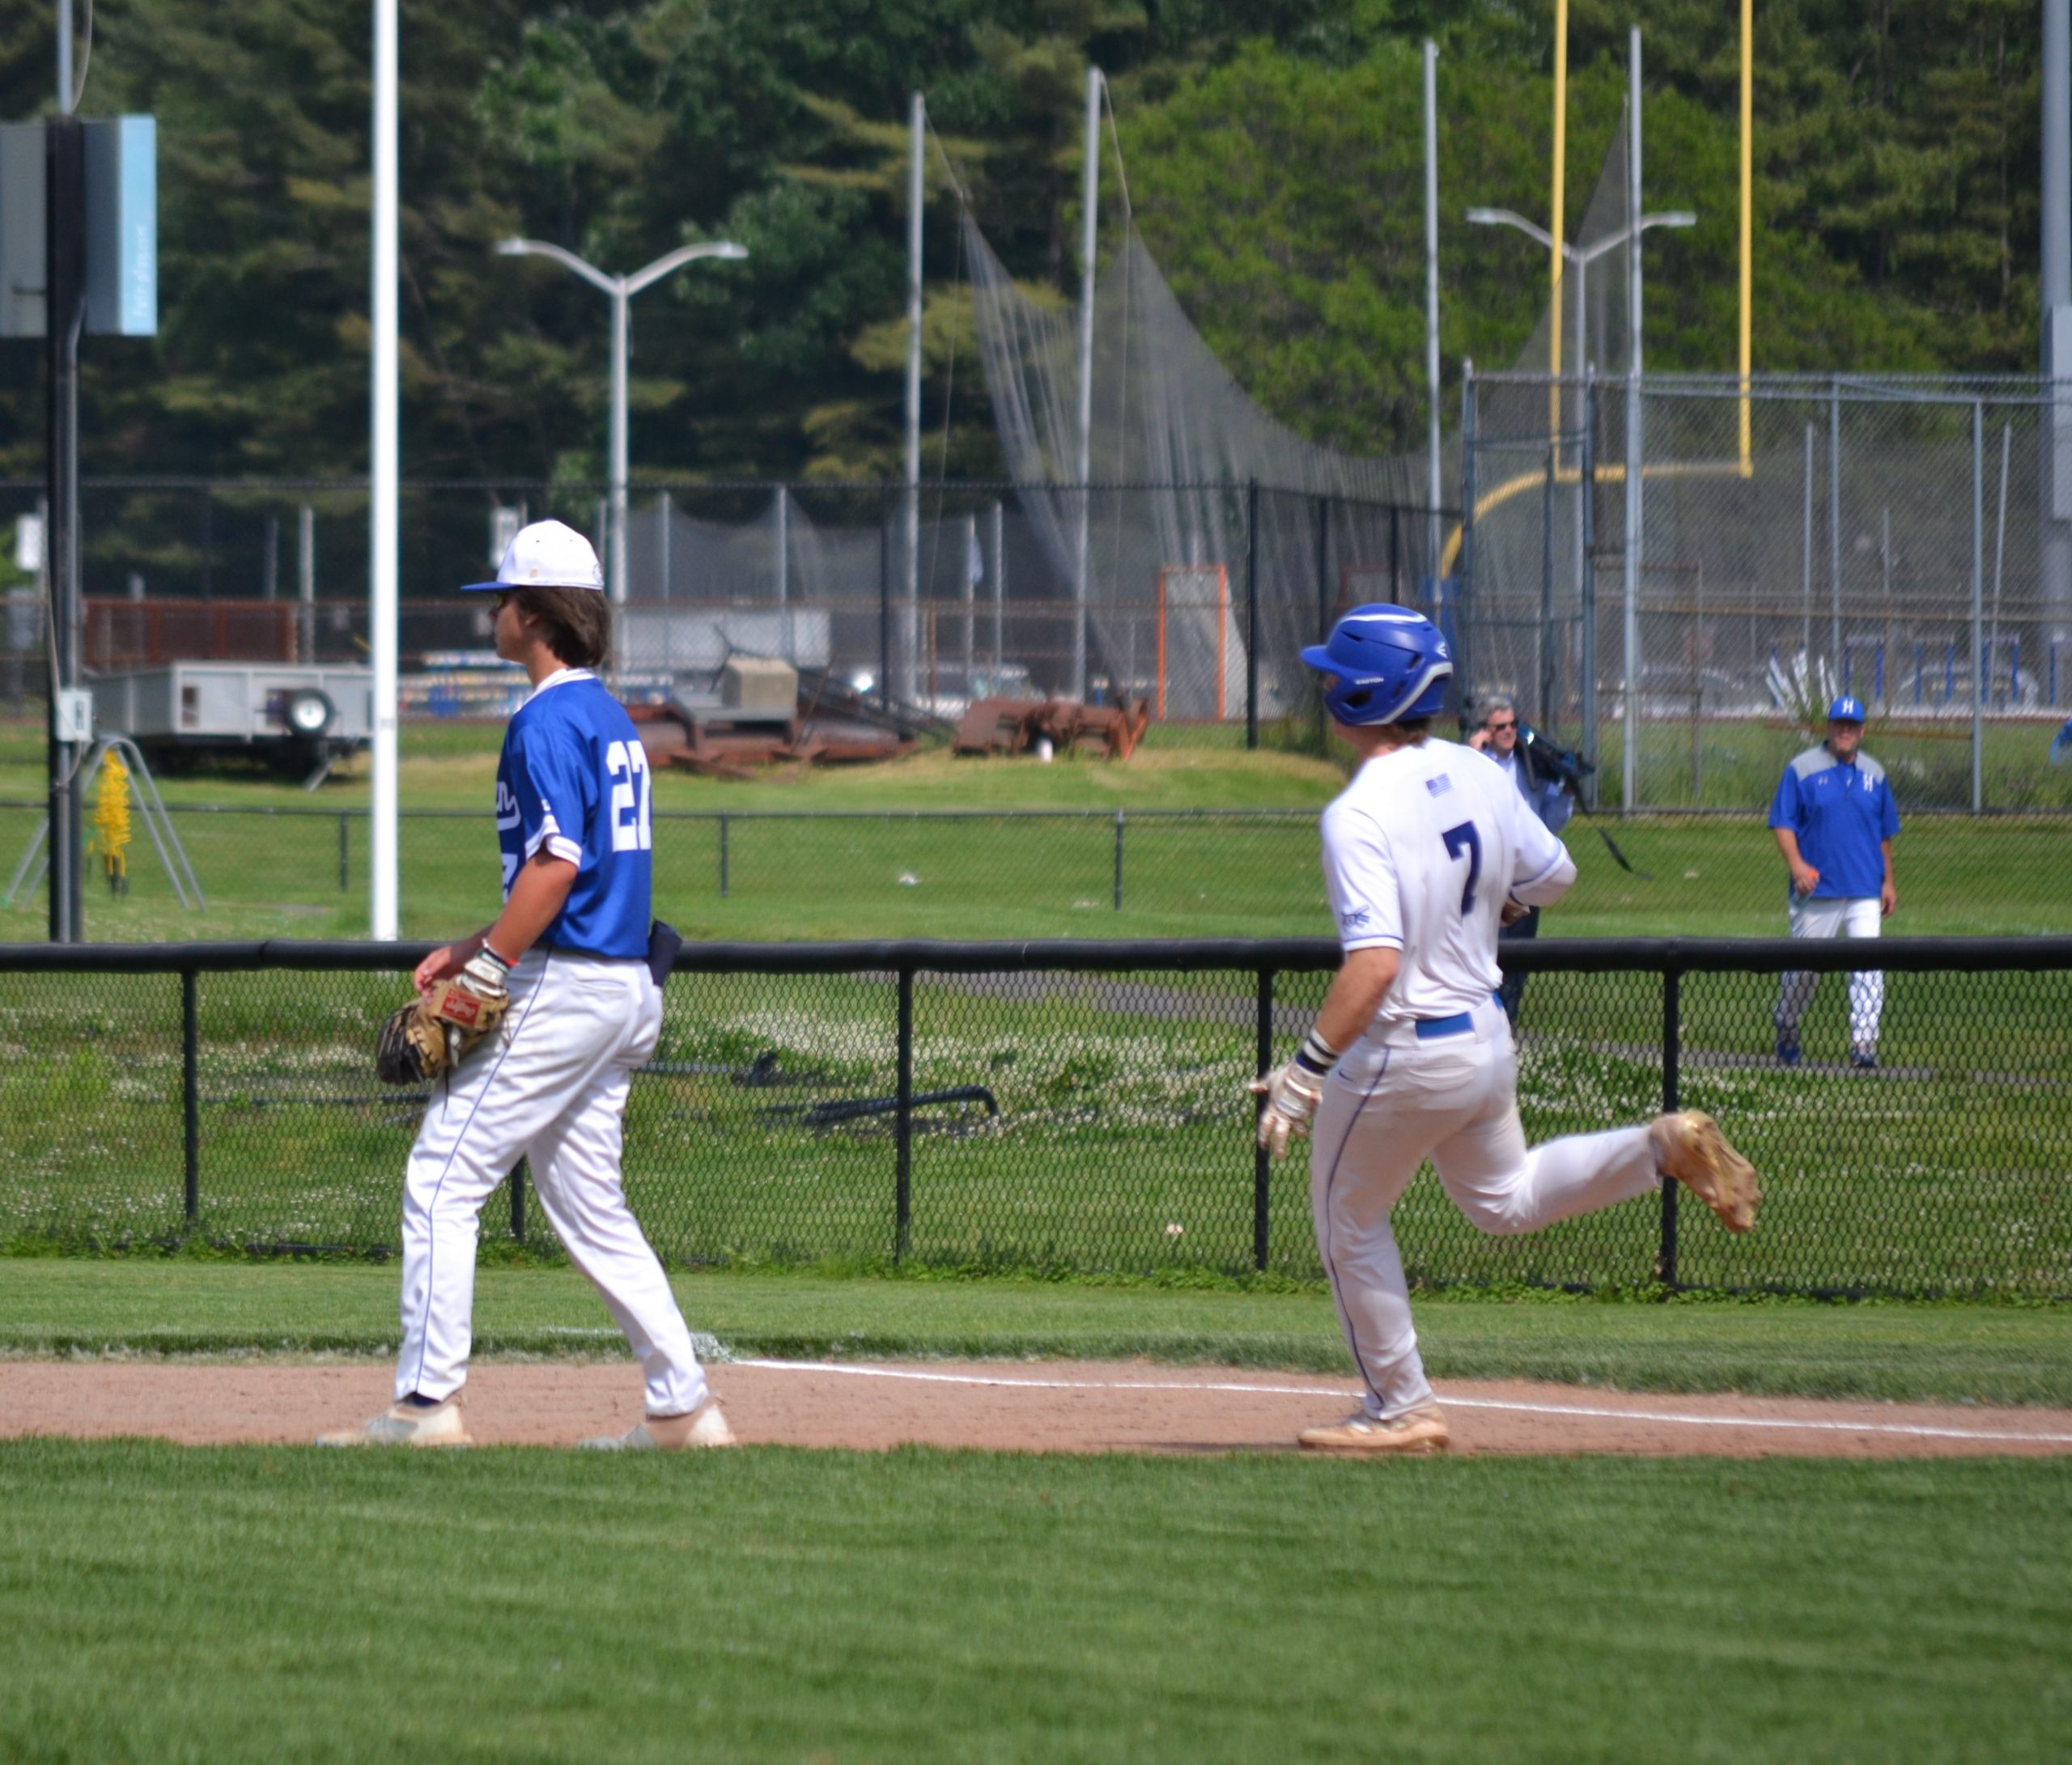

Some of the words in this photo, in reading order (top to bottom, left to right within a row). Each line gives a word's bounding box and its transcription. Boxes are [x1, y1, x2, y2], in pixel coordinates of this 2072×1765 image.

[1842, 699, 1854, 714] H
[606, 740, 652, 852] 27
[1863, 774, 1874, 792] H
[1441, 820, 1483, 916] 7
